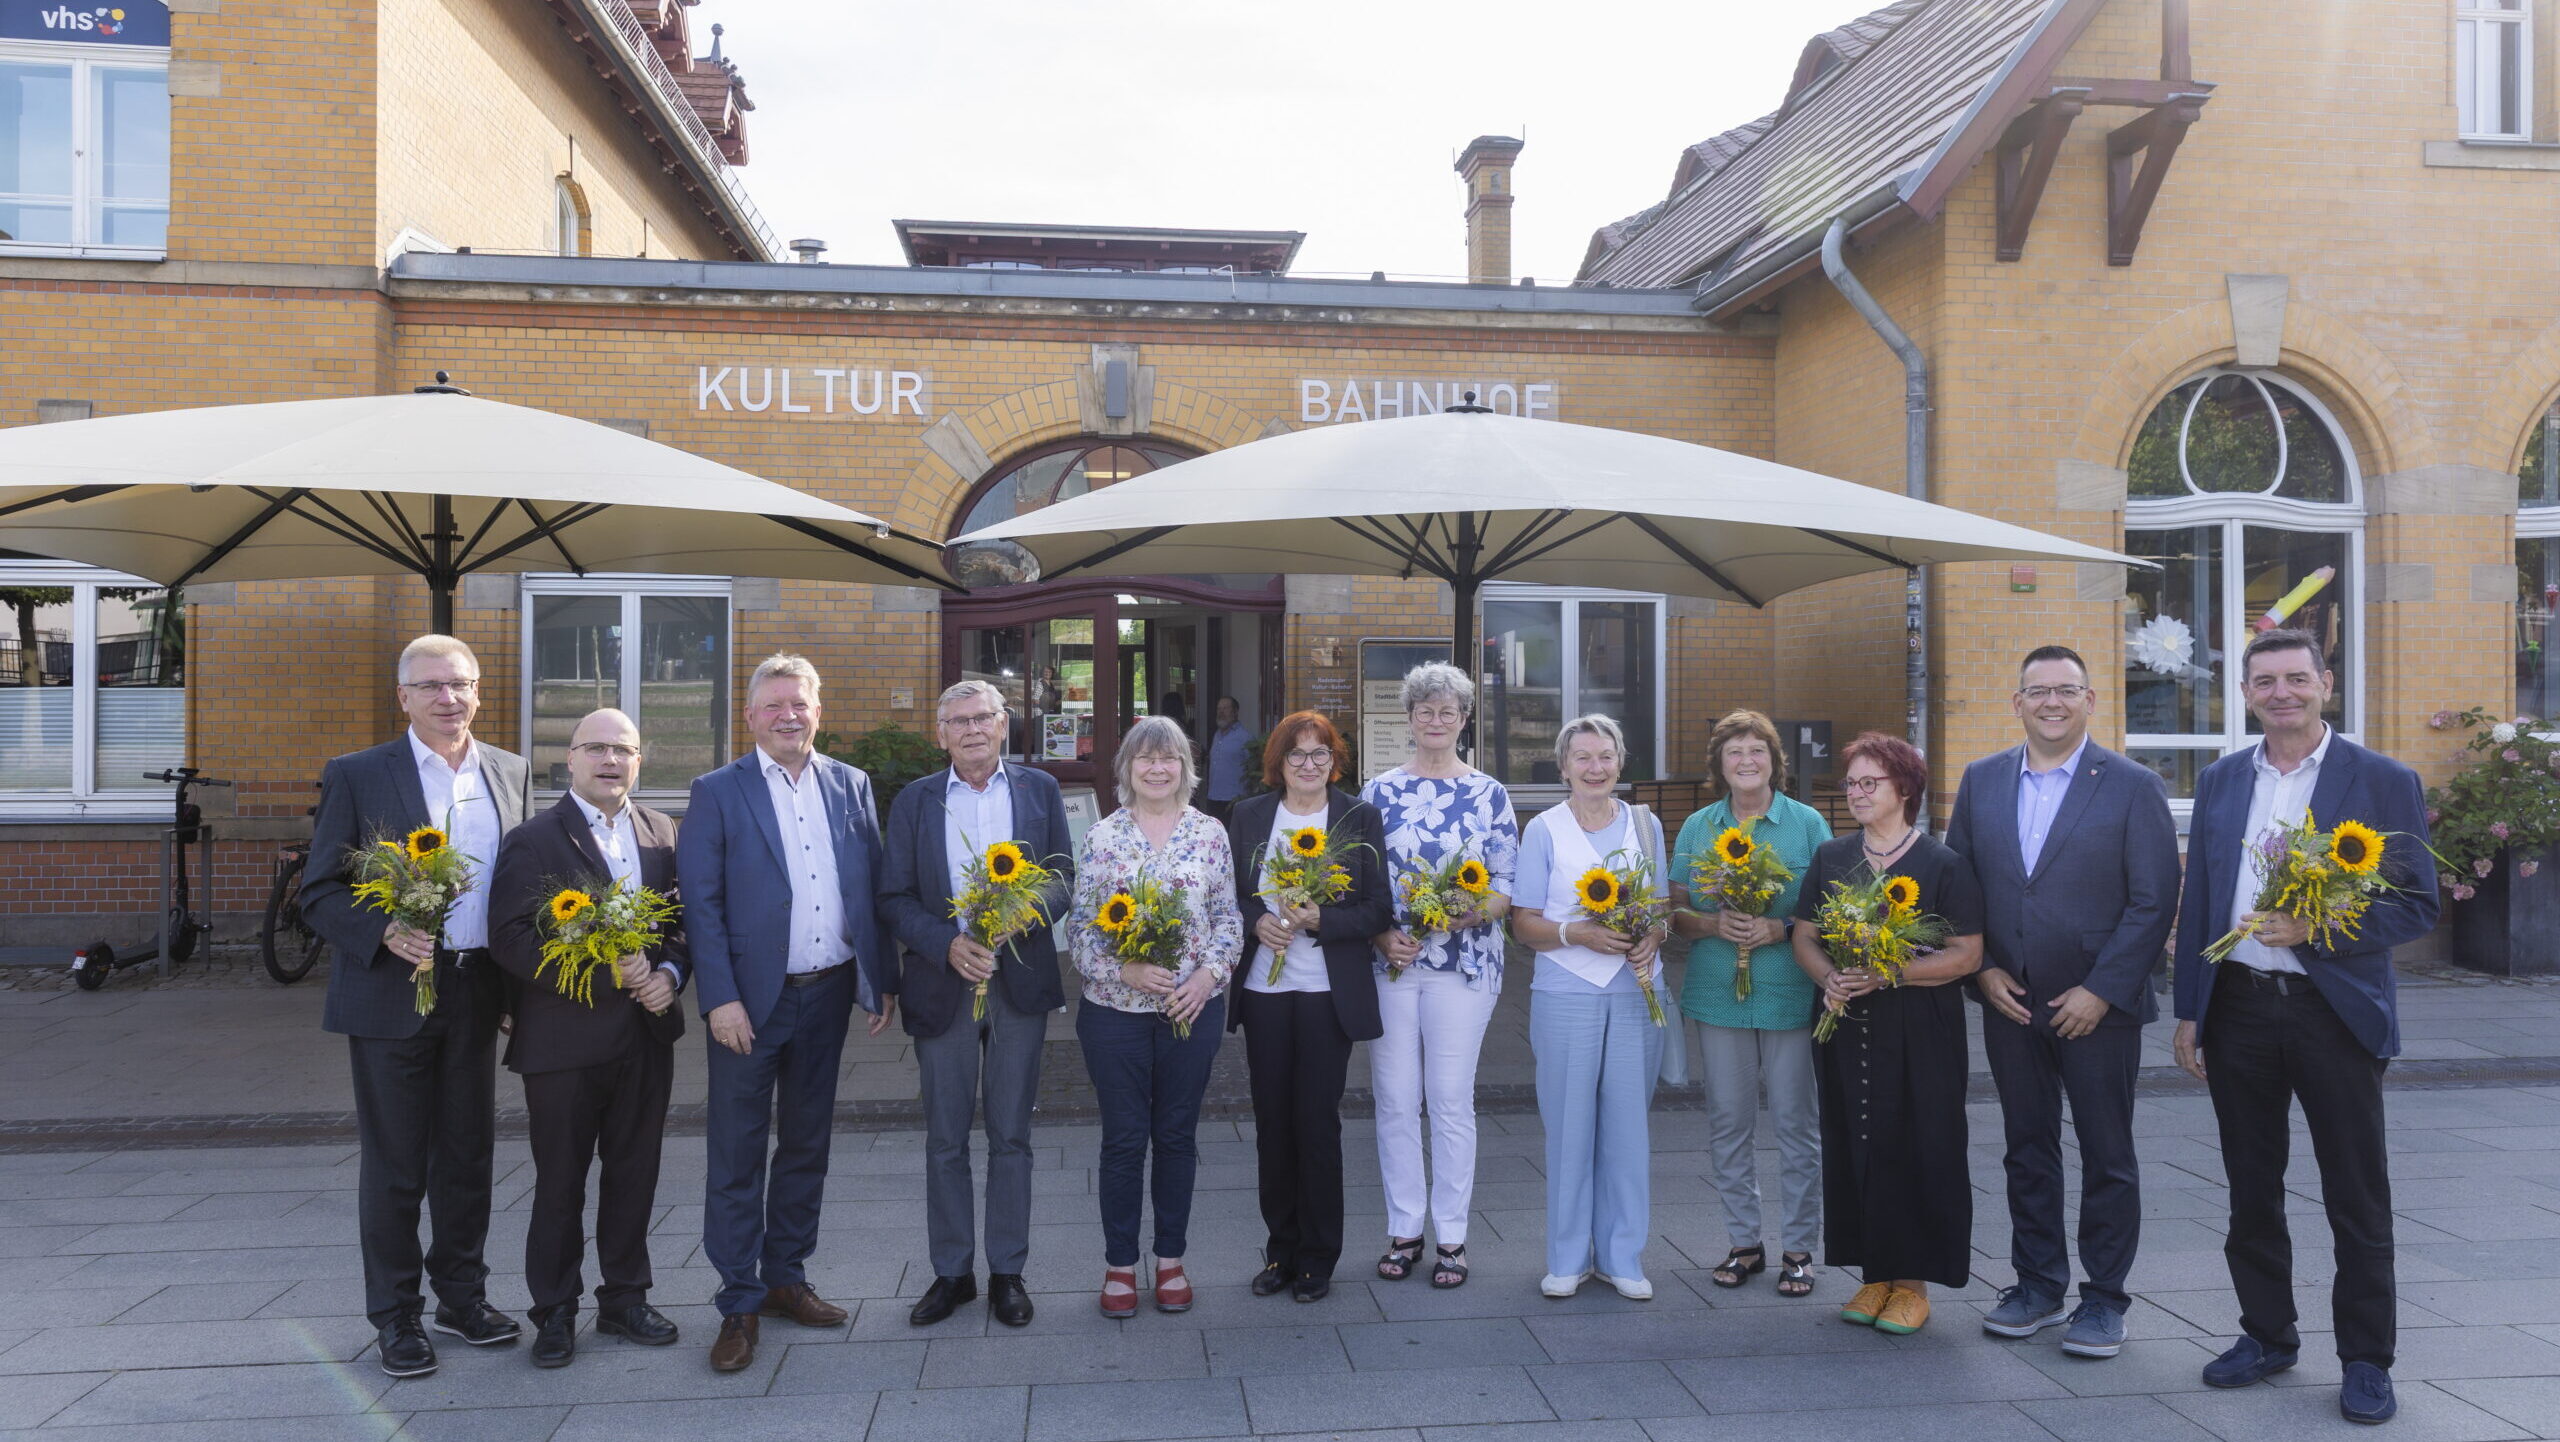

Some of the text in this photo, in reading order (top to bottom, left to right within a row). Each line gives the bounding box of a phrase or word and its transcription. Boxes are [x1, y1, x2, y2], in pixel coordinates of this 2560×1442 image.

[41, 6, 94, 31] vhs
[699, 366, 924, 416] KULTUR
[1301, 379, 1552, 423] BAHNHOF
[1065, 802, 1080, 814] hek
